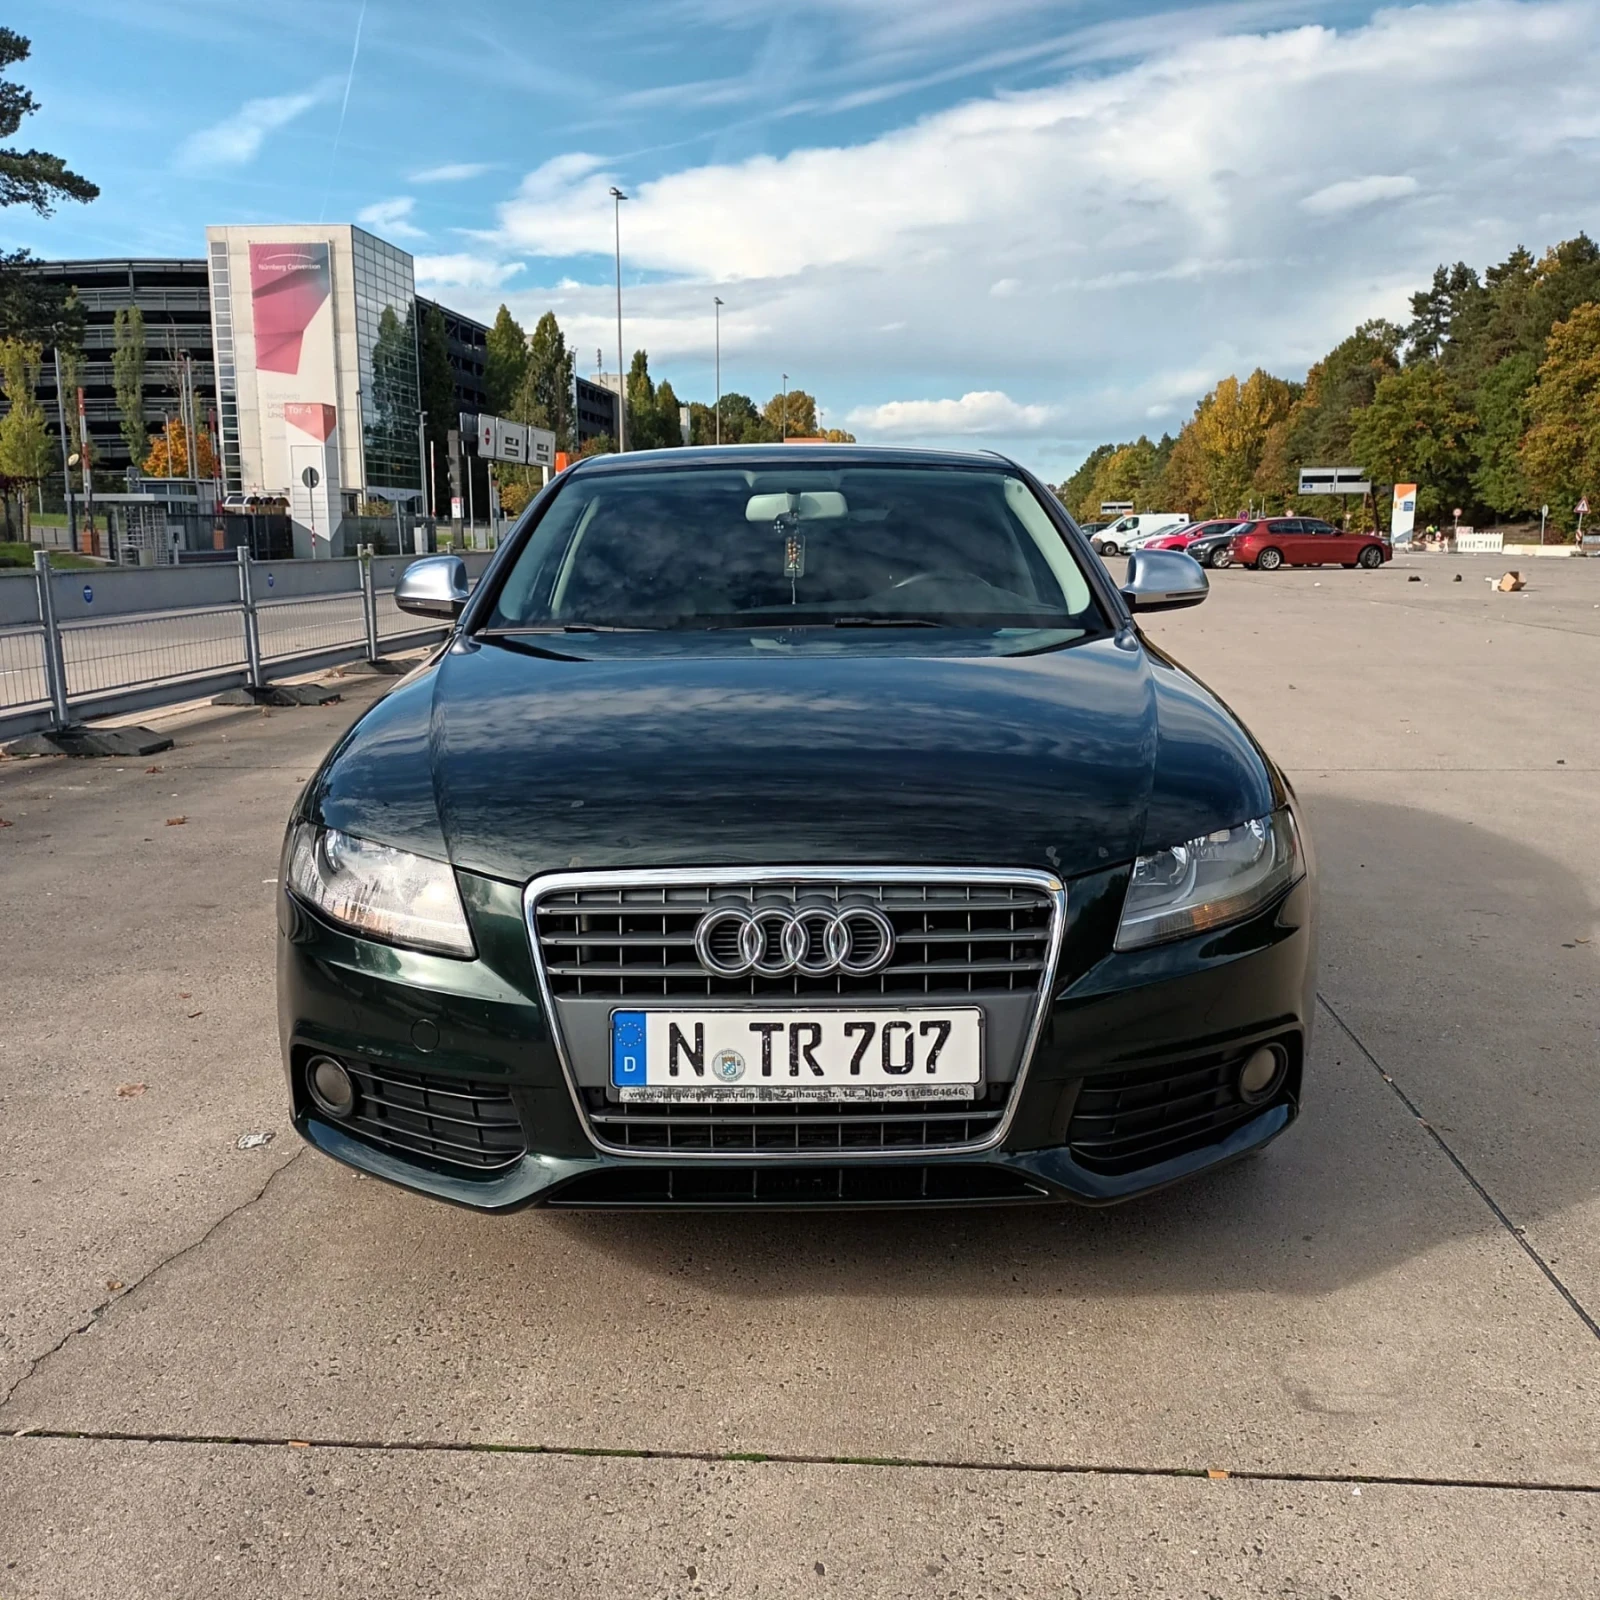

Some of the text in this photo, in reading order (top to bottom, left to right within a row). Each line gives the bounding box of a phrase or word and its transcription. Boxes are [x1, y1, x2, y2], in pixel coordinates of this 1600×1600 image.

[258, 263, 321, 272] Nürnberg Convention
[287, 405, 302, 415] Tor
[305, 405, 312, 415] 4
[668, 1020, 952, 1078] N TR 707
[623, 1056, 637, 1073] D
